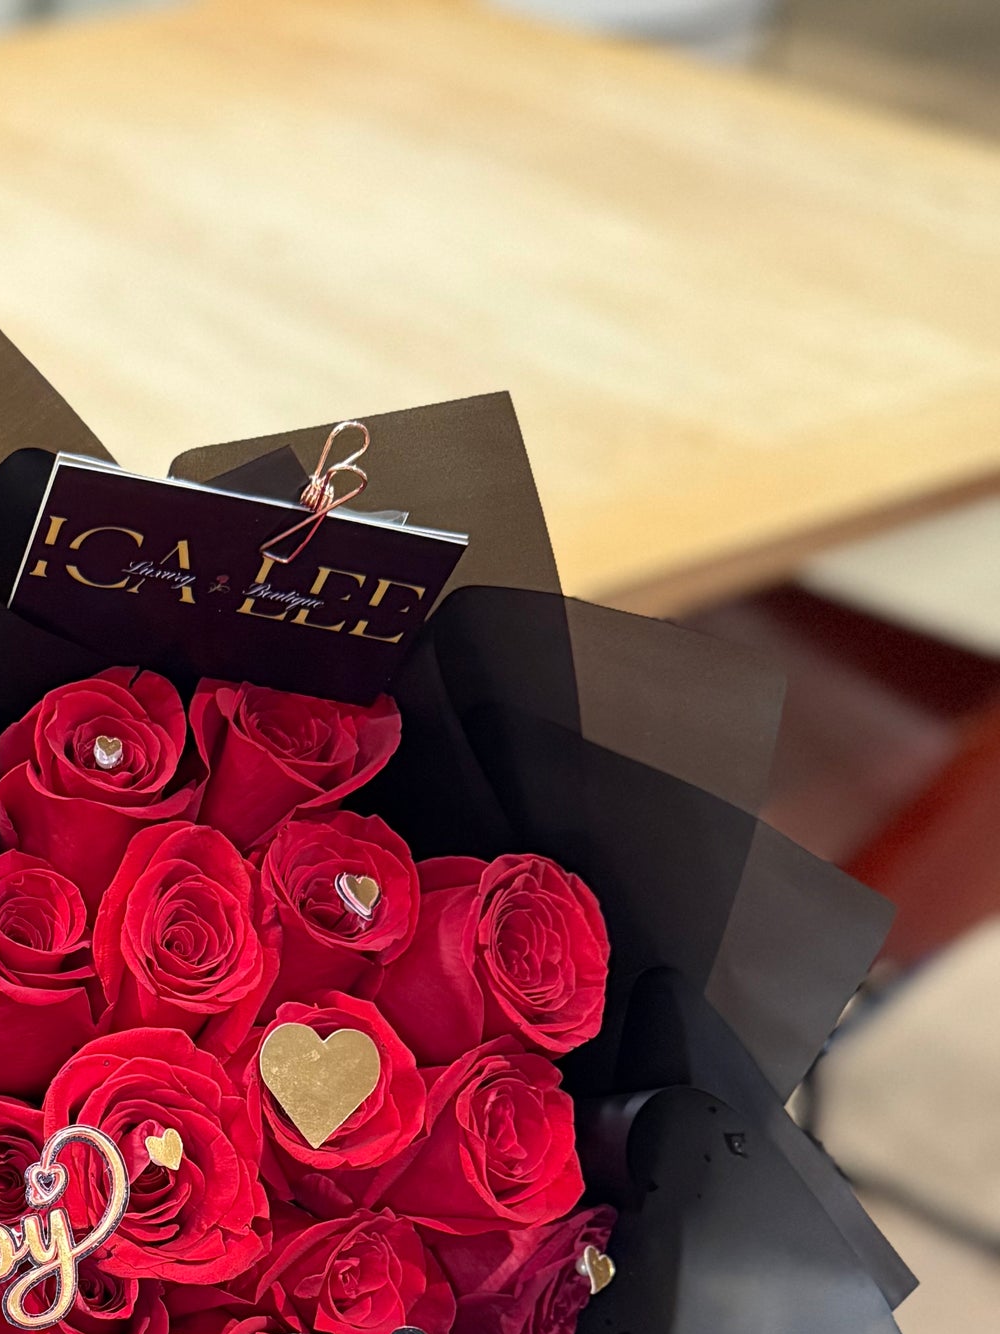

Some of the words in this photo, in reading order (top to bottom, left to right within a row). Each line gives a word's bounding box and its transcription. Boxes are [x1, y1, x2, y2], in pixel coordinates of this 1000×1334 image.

[29, 515, 196, 604] ICA
[236, 554, 426, 643] LEE
[121, 561, 196, 590] Luxury
[242, 583, 325, 611] Boutique
